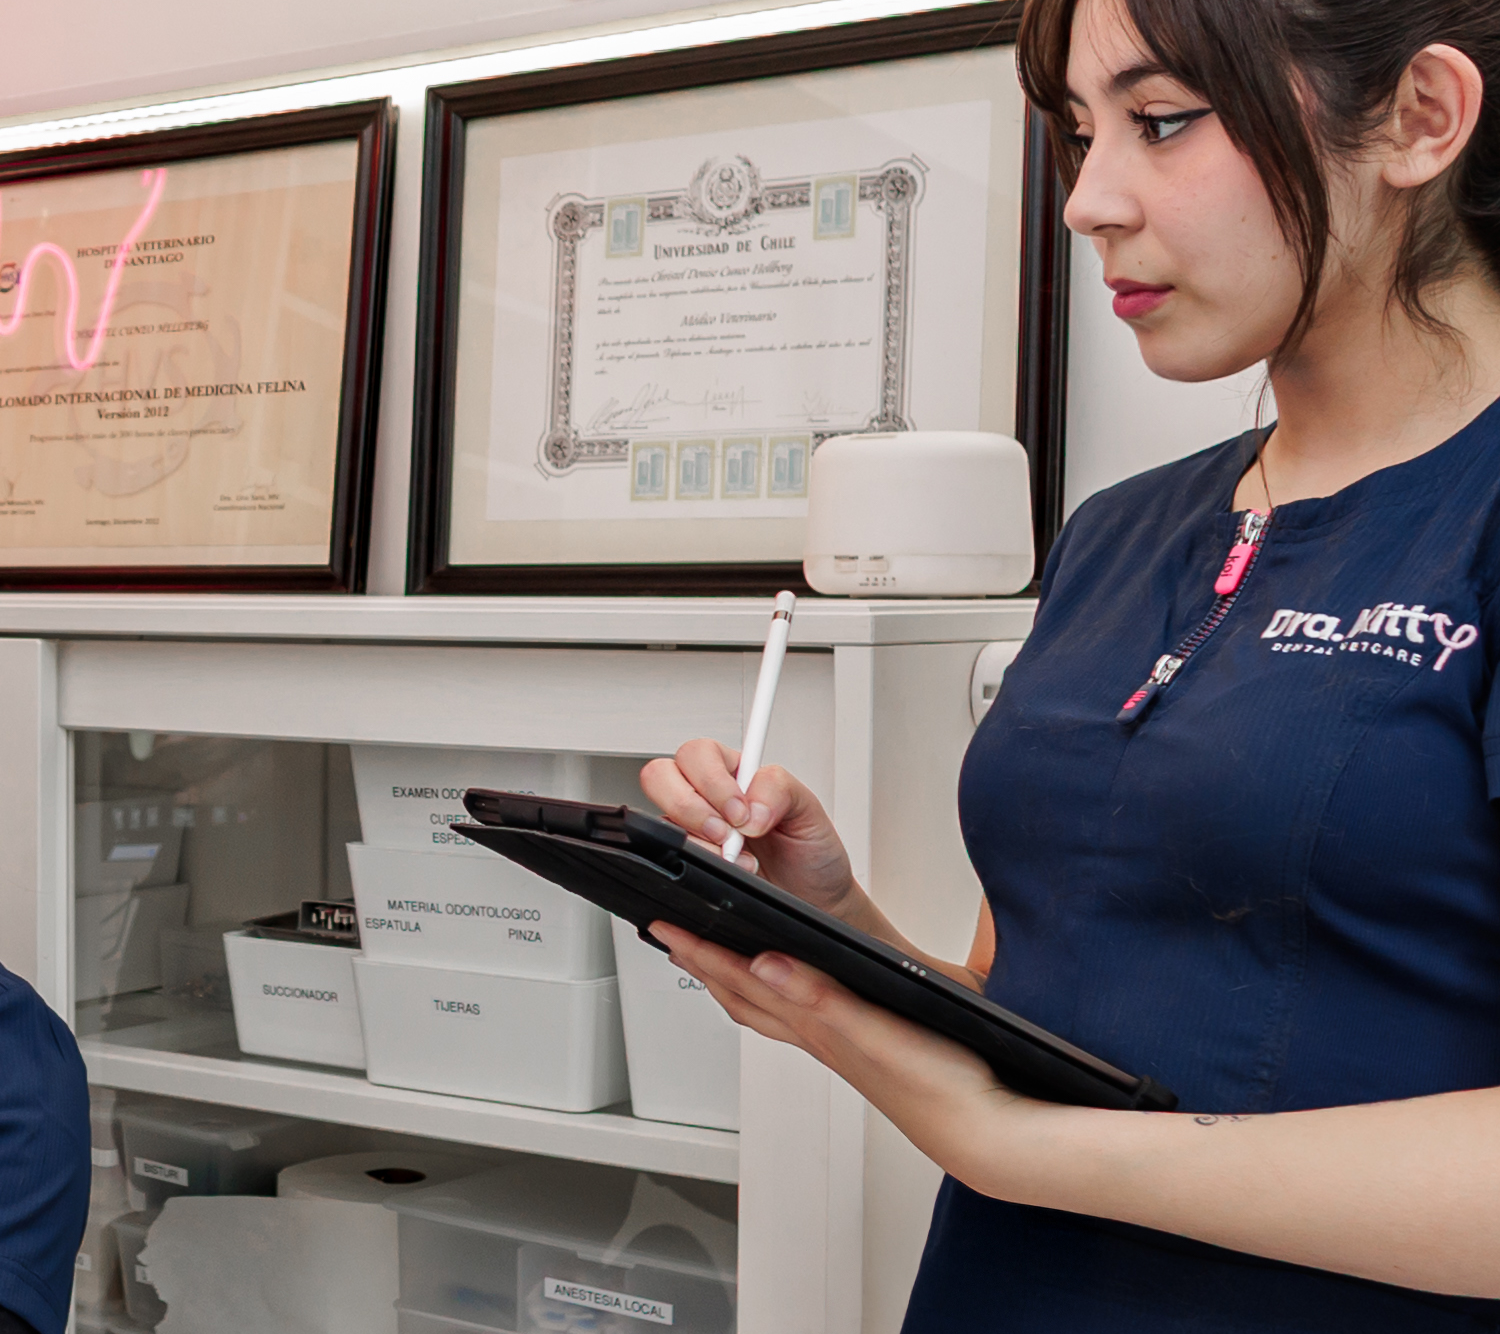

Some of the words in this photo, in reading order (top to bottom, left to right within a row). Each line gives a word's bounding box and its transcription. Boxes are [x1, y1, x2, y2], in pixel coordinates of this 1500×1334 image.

[135, 234, 216, 252] VETERINARIO
[653, 242, 730, 260] UNIVERSIDAD
[736, 240, 752, 252] DE
[760, 235, 796, 251] CHILE
[54, 388, 161, 406] INTERNACIONAL
[163, 386, 182, 399] DE
[184, 382, 253, 398] MEDICINA
[256, 380, 306, 394] FELINA
[96, 407, 141, 420] Versión
[143, 406, 170, 418] 2012
[1271, 641, 1334, 656] DENTAL
[1339, 640, 1422, 667] VETCARE
[391, 786, 439, 800] EXAMEN
[387, 899, 443, 915] MATERIAL
[445, 904, 542, 923] ODONTOLOGICO
[365, 918, 422, 934] ESPATULA
[507, 928, 543, 943] PINZA
[262, 984, 339, 1003] SUCCIONADOR
[677, 977, 707, 992] CAJ
[433, 1000, 481, 1016] TIJERAS
[553, 1282, 622, 1312] ANESTESIA
[624, 1298, 667, 1320] LOCAL
